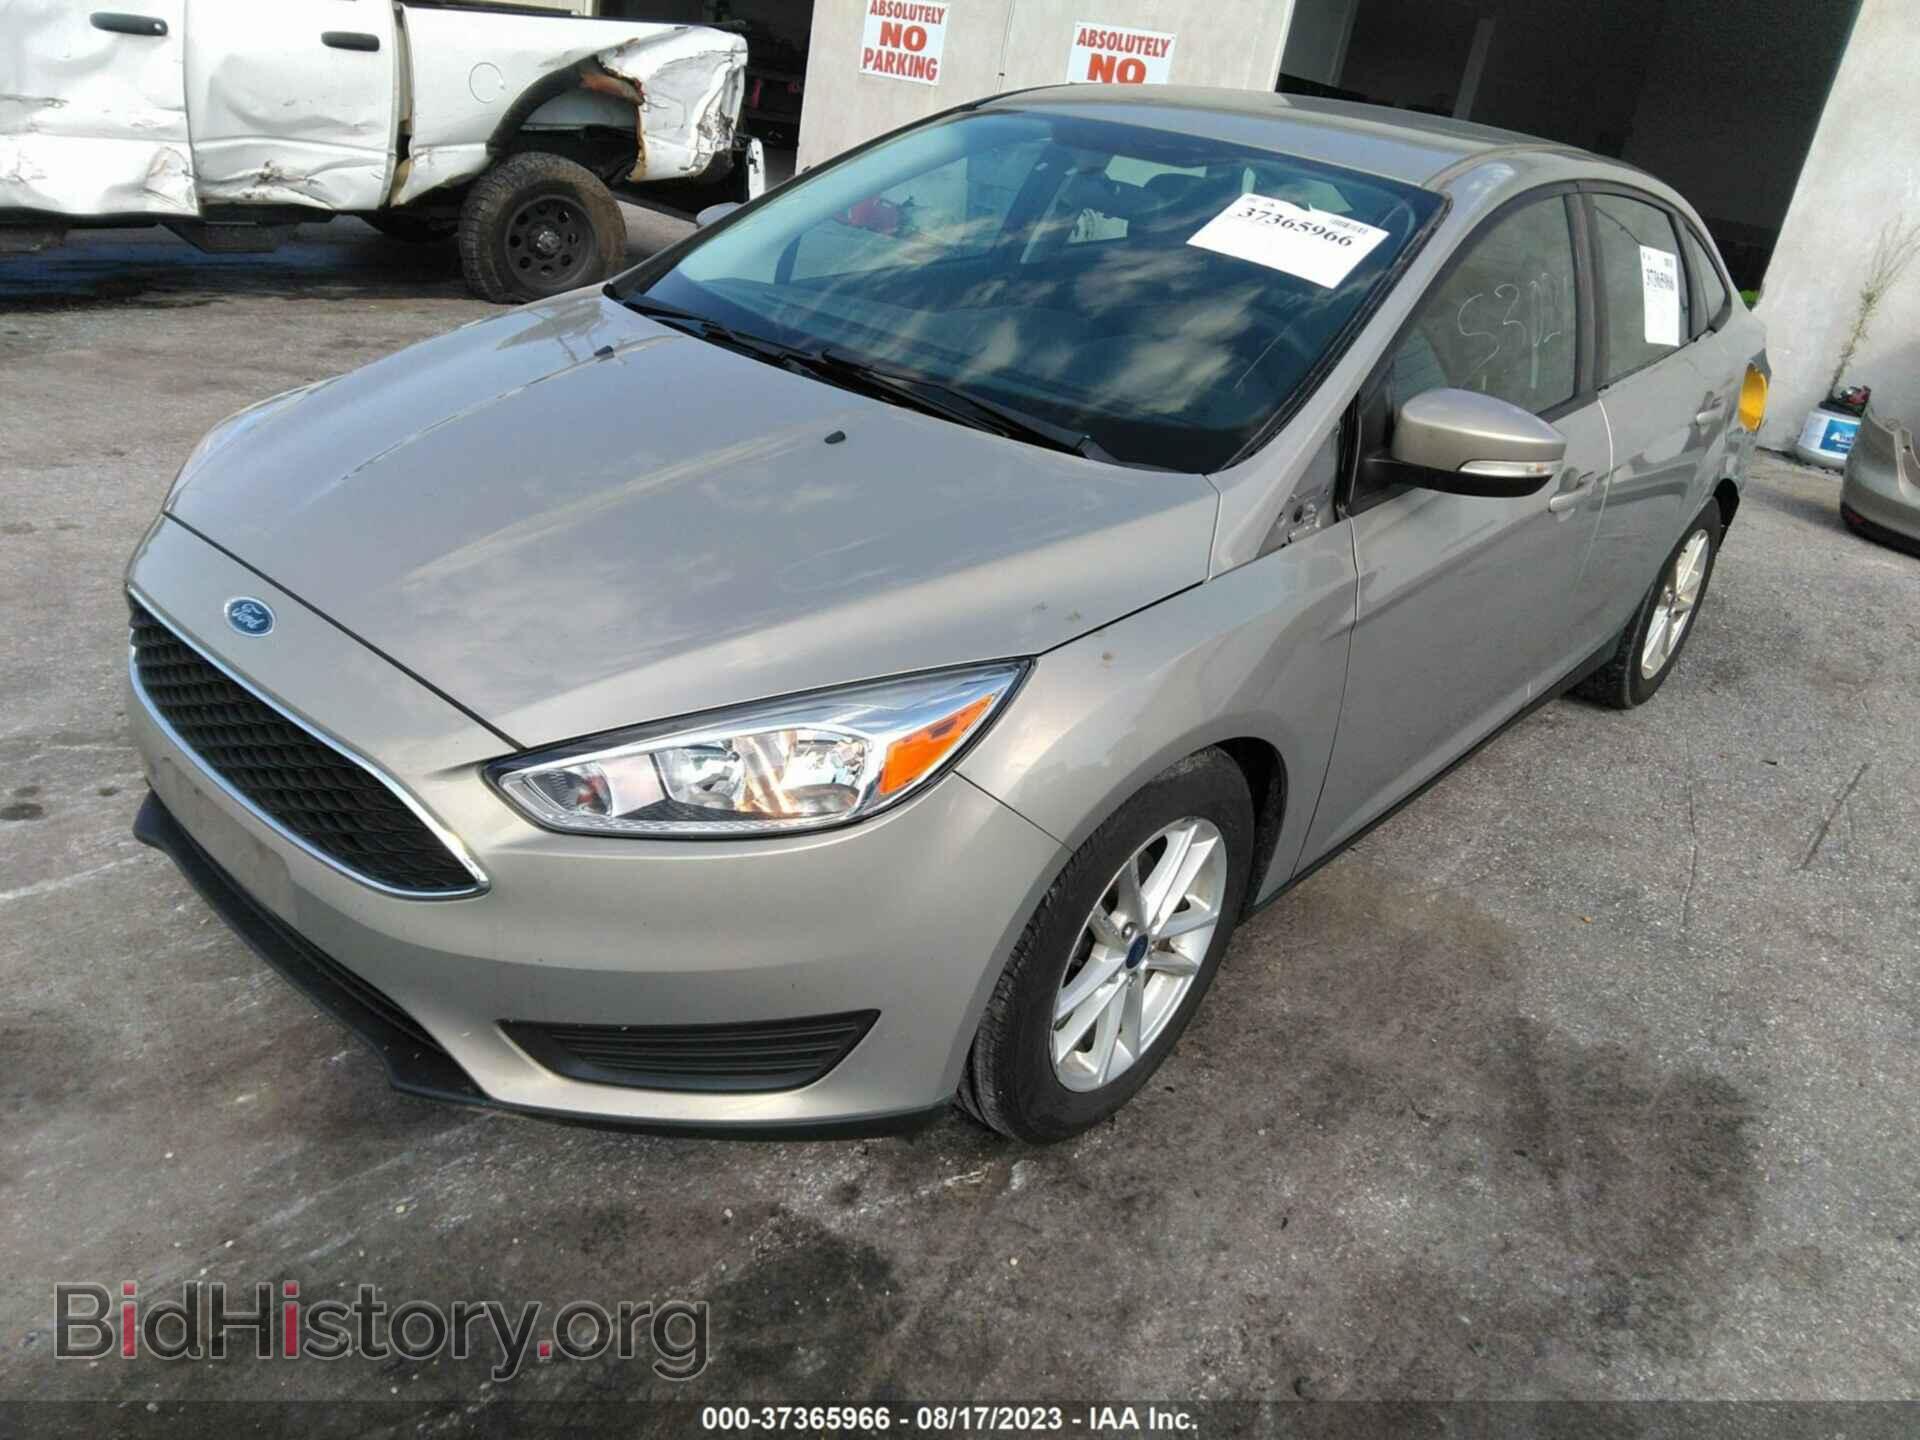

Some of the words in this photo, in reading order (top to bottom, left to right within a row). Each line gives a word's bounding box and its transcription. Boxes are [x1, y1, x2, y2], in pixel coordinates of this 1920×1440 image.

[869, 0, 946, 25] ABSOLUTELY
[879, 21, 928, 53] NO
[1076, 27, 1171, 59] ABSOLUTELY
[862, 47, 939, 82] PARKING
[1087, 53, 1148, 84] NO
[1236, 207, 1354, 248] 37365966
